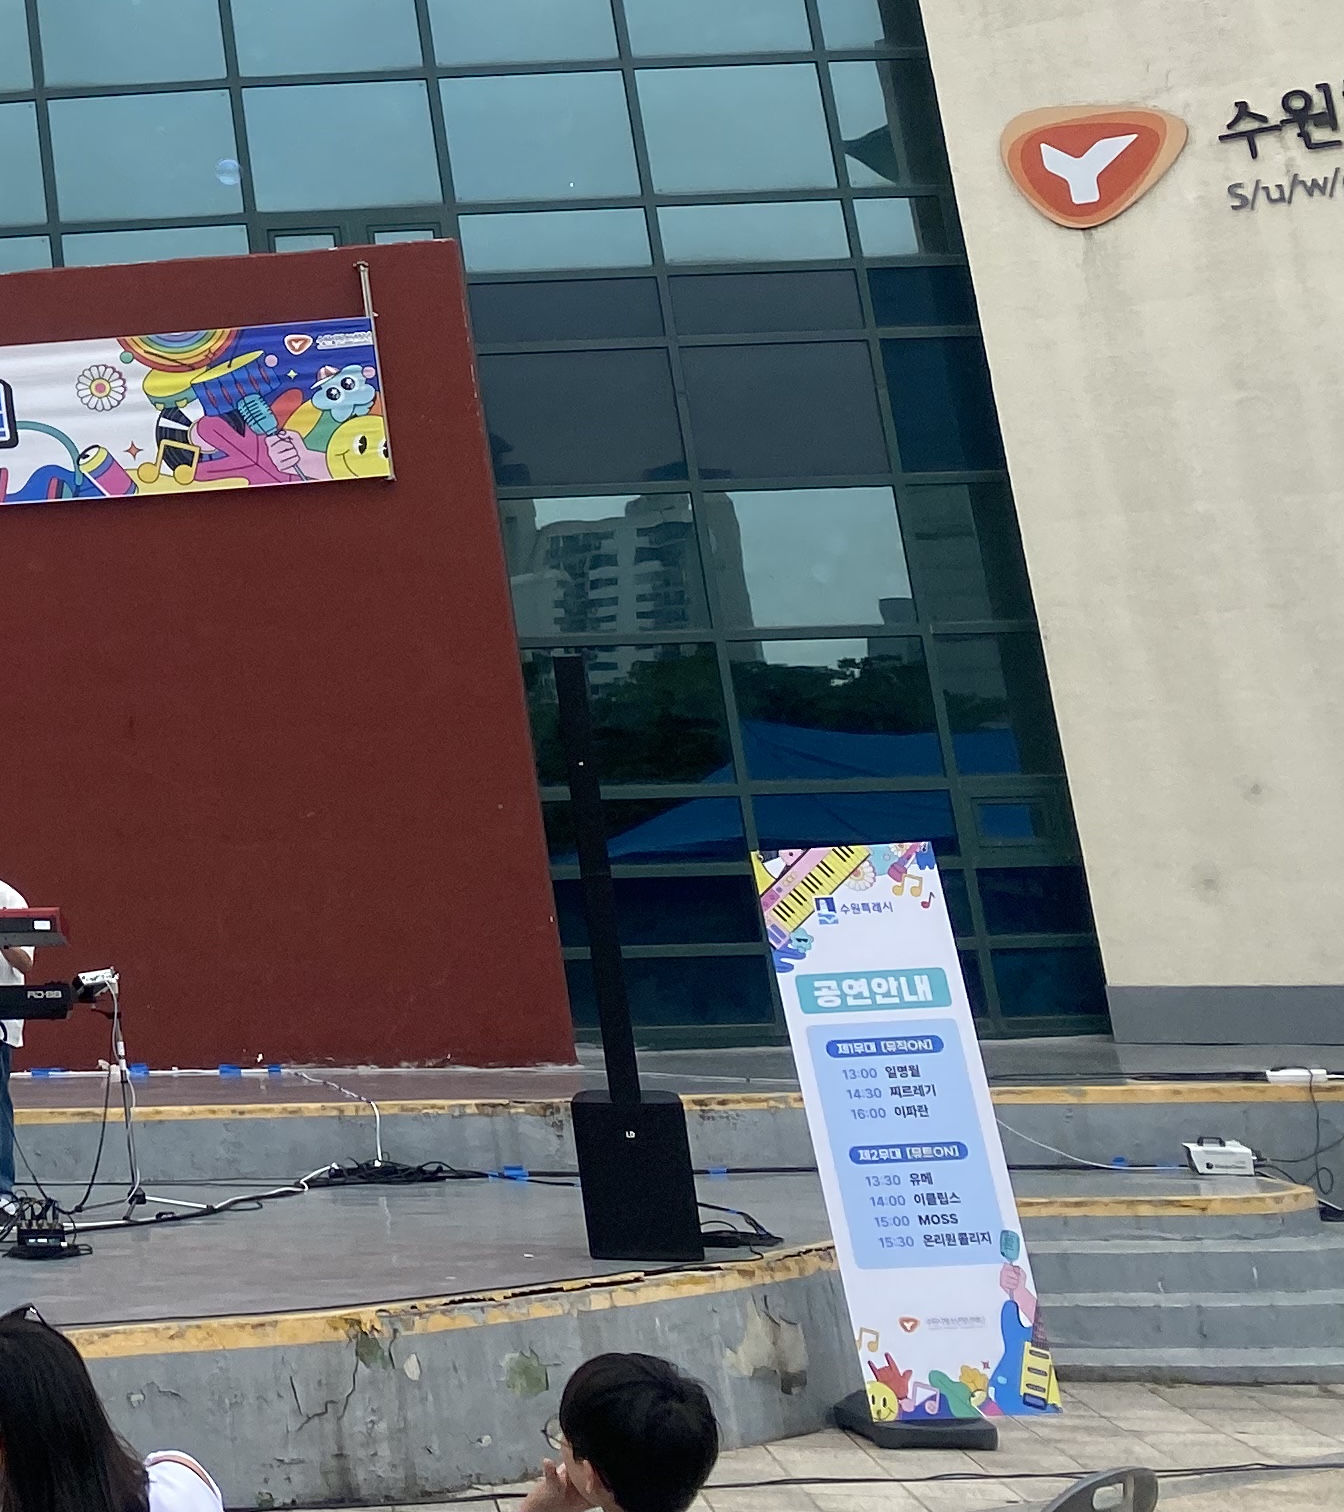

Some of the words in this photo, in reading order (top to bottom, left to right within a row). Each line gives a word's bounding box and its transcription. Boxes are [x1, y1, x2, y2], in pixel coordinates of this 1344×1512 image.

[1218, 79, 1344, 159] 수원
[1227, 167, 1344, 210] S/u/w/
[813, 974, 933, 1008] 공연안내
[842, 1068, 878, 1080] 13:00
[846, 1088, 882, 1099] 14:30
[851, 1108, 887, 1120] 16:00
[865, 1174, 901, 1187] 13:30
[870, 1195, 906, 1207] 14:00
[874, 1215, 910, 1228] 15:00
[917, 1213, 959, 1226] MOSS
[879, 1236, 914, 1248] 15:30
